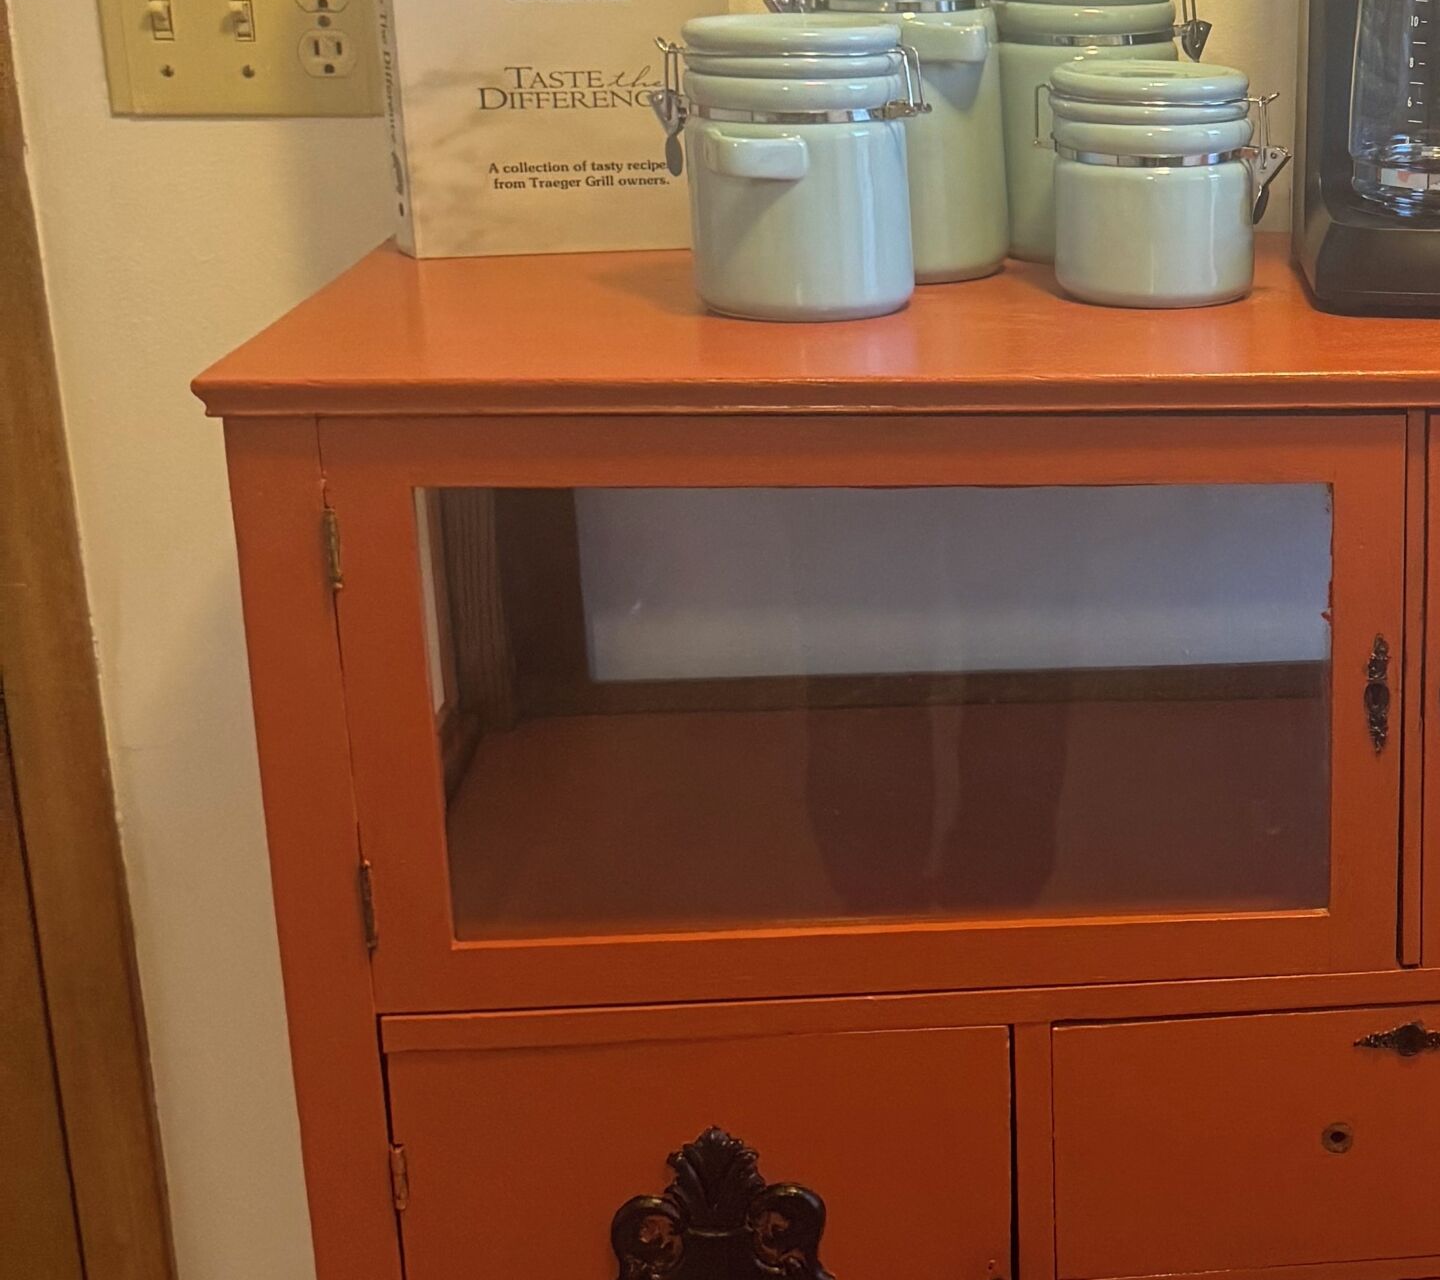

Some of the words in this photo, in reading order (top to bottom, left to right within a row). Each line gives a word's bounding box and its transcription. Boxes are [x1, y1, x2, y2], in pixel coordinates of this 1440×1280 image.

[1410, 15, 1419, 27] 10
[504, 66, 604, 90] TASTE
[608, 64, 664, 88] the
[488, 163, 499, 174] A
[503, 161, 569, 174] collection
[573, 160, 587, 173] of
[591, 161, 623, 174] tasty
[627, 160, 667, 173] recipe
[494, 177, 526, 190] from
[529, 177, 581, 190] Traeger
[585, 175, 614, 187] Grill
